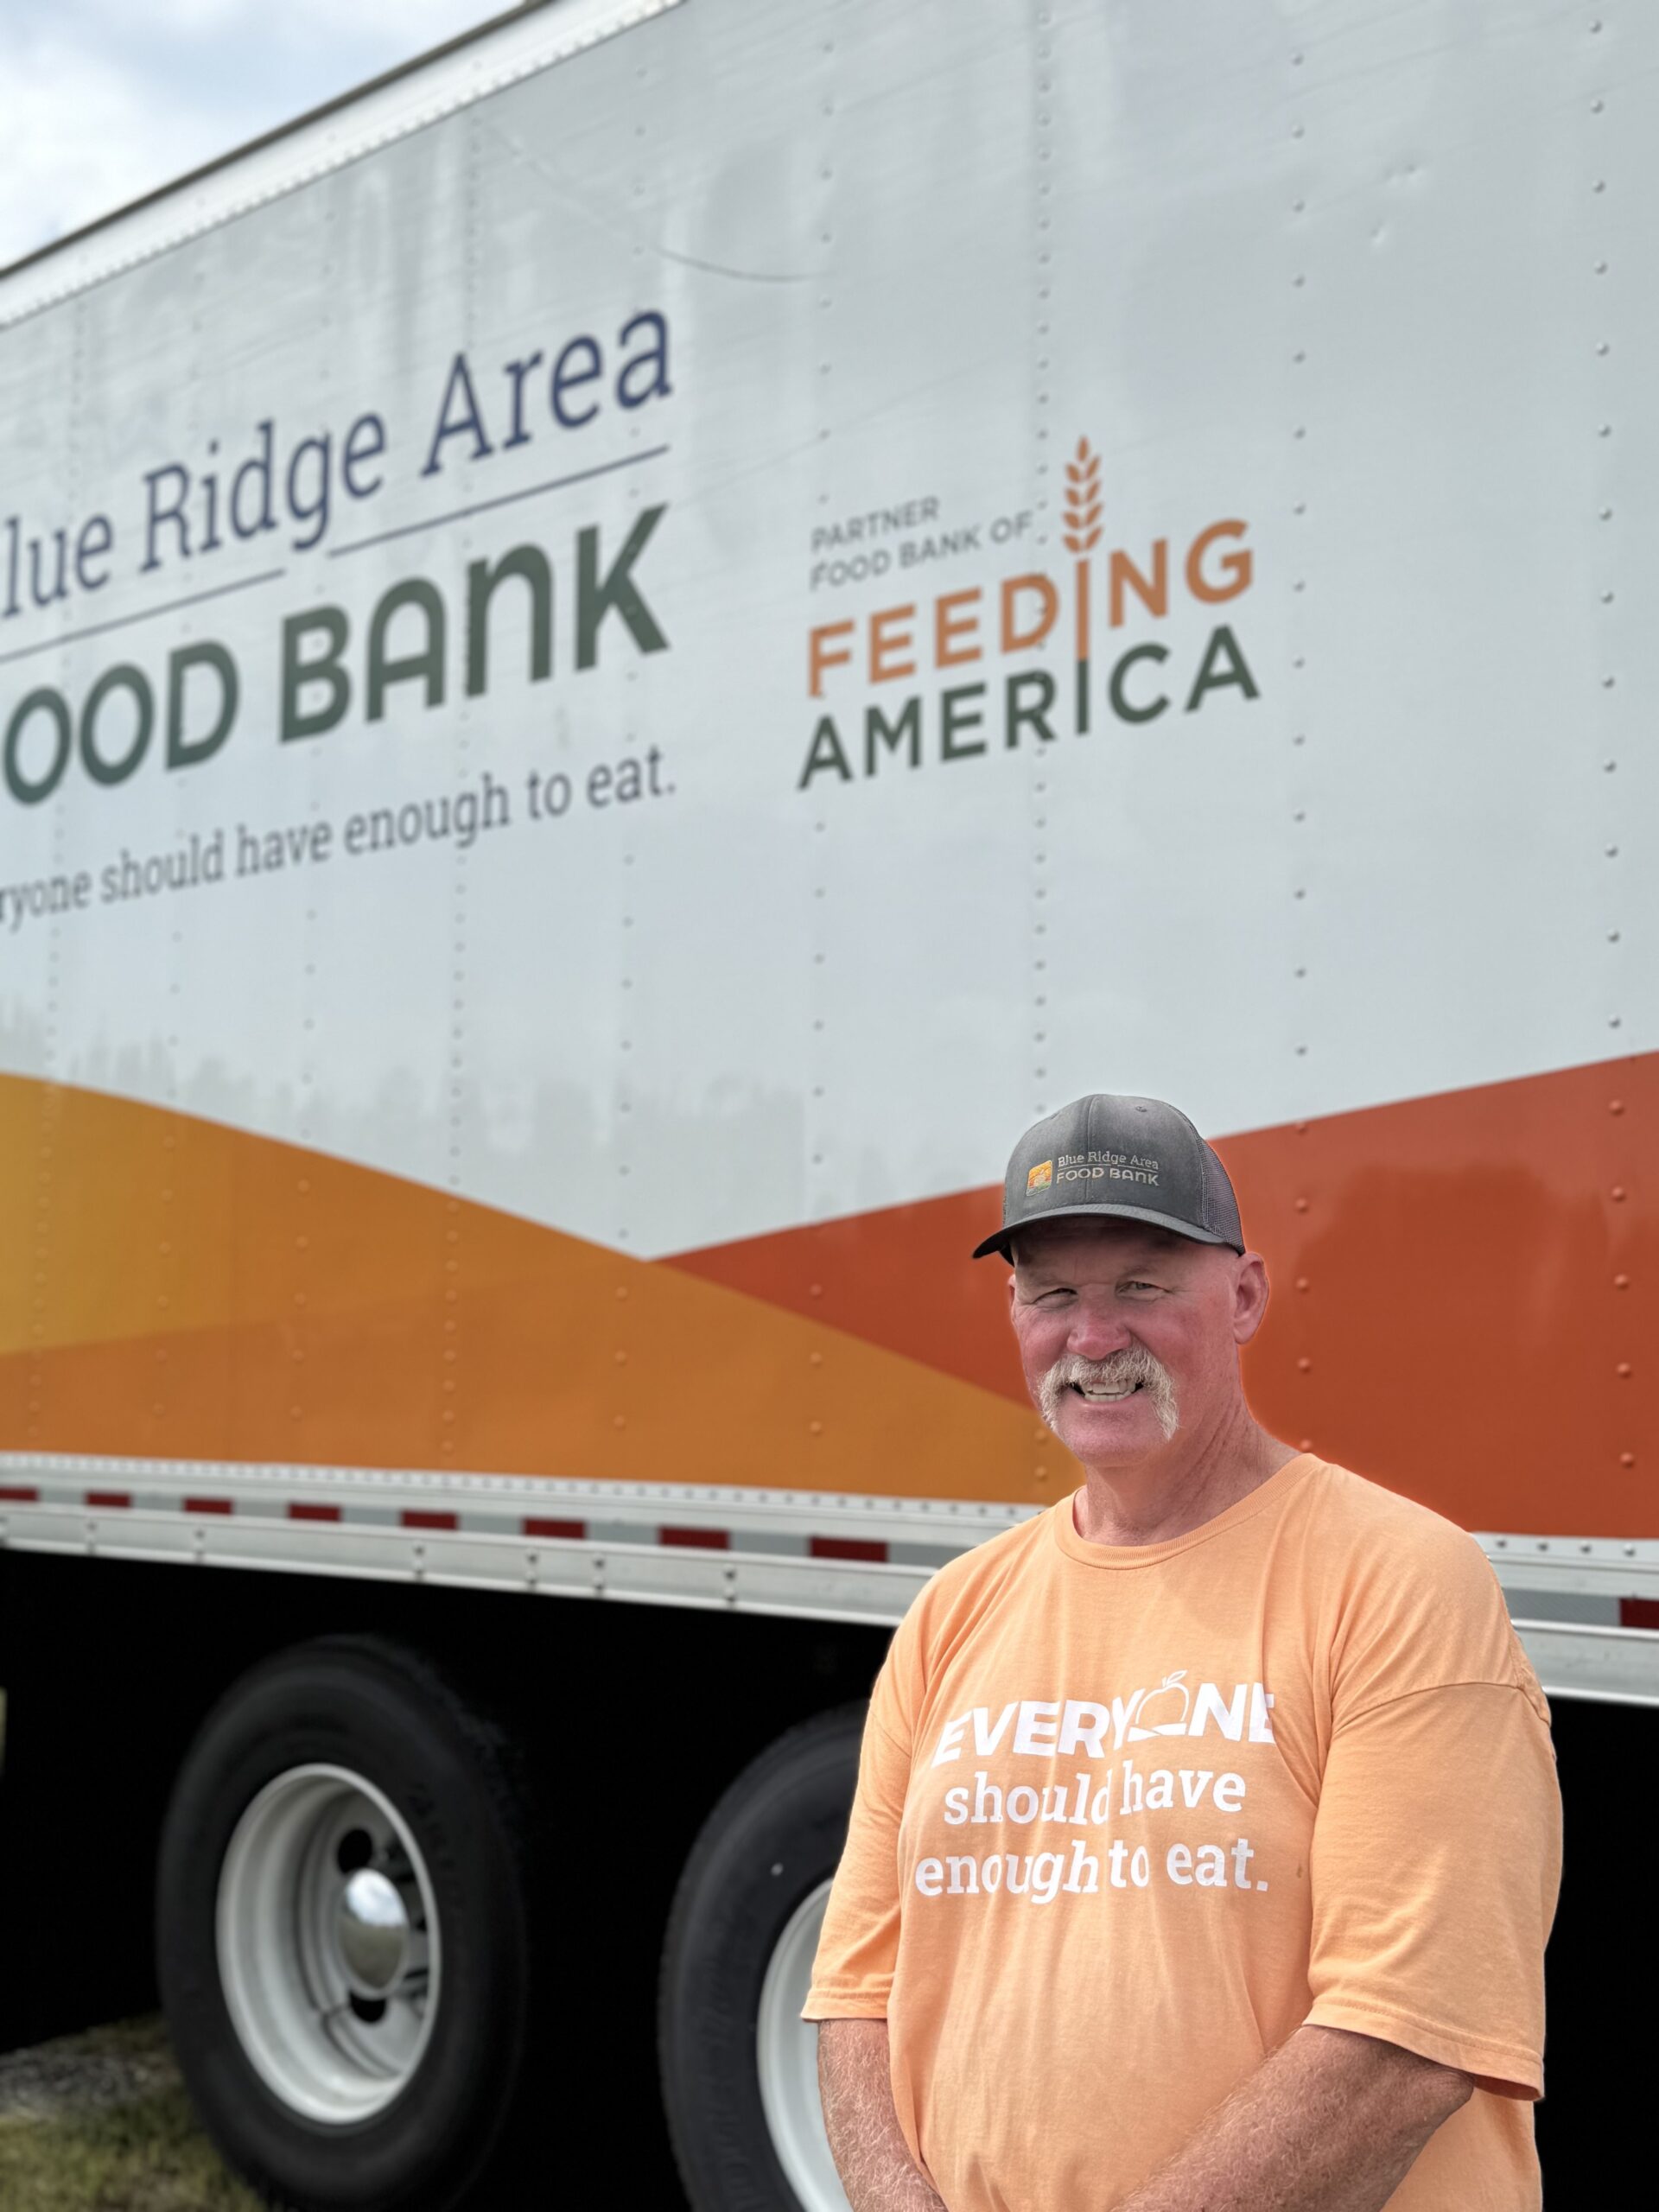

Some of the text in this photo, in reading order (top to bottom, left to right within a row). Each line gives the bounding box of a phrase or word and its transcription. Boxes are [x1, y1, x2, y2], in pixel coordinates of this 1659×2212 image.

[139, 411, 387, 575] Ridge
[420, 309, 673, 478] Area
[809, 509, 1034, 592] FOOD BANK OF
[810, 495, 940, 555] PARTNER
[809, 518, 1254, 698] FEEDING
[797, 624, 1261, 792] AMERICA
[100, 830, 225, 905] should
[236, 817, 333, 880] have
[345, 772, 511, 855] enough
[526, 768, 572, 821] to
[587, 745, 677, 810] eat.
[1056, 1166, 1105, 1184] FOOD
[1058, 1150, 1159, 1170] Blue Ridge Area
[944, 1759, 1247, 1826] should have
[915, 1838, 1268, 1904] enough to eat.
